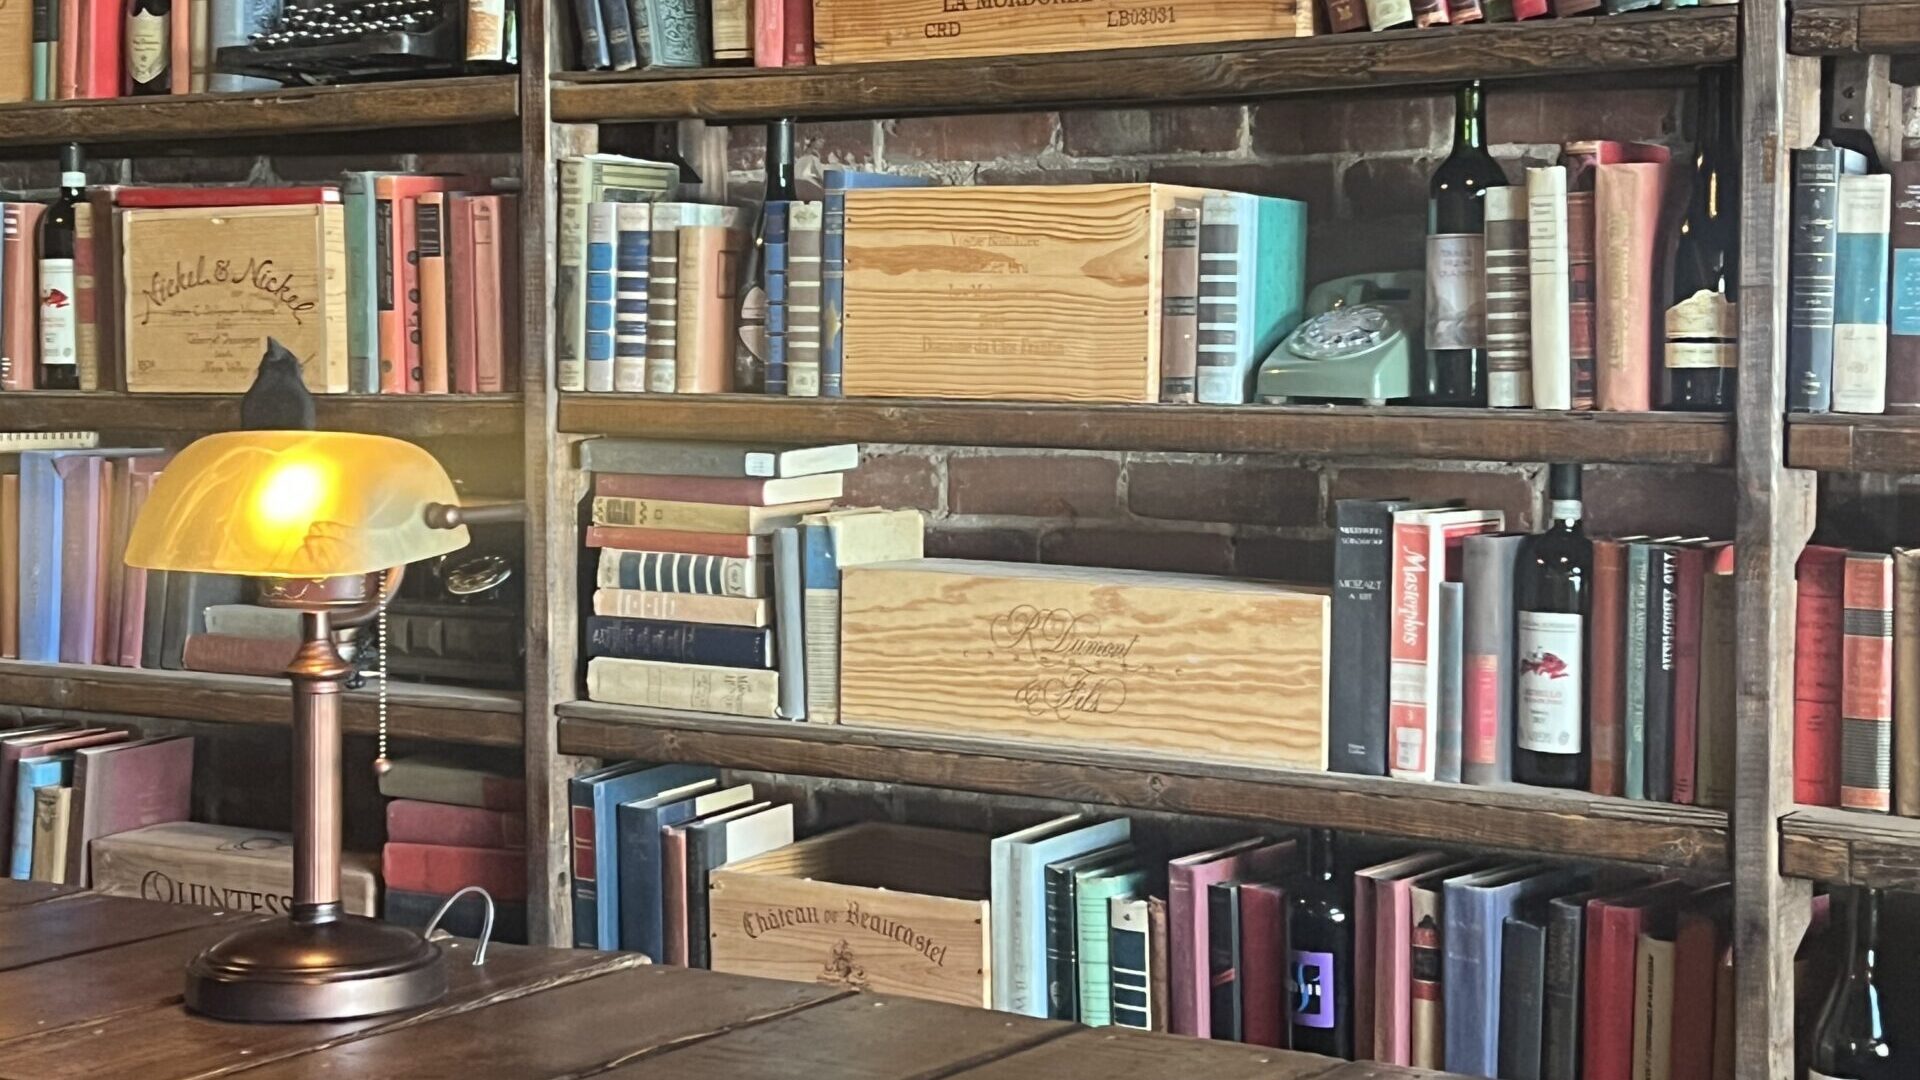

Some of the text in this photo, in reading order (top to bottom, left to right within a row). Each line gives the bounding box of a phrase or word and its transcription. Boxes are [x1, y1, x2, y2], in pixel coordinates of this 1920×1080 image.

[924, 22, 961, 38] CRD
[1107, 7, 1176, 27] LB03031
[214, 260, 231, 282] &
[231, 257, 315, 325] Nickel
[1399, 545, 1427, 646] Masterplots
[846, 899, 948, 967] Beaucastel
